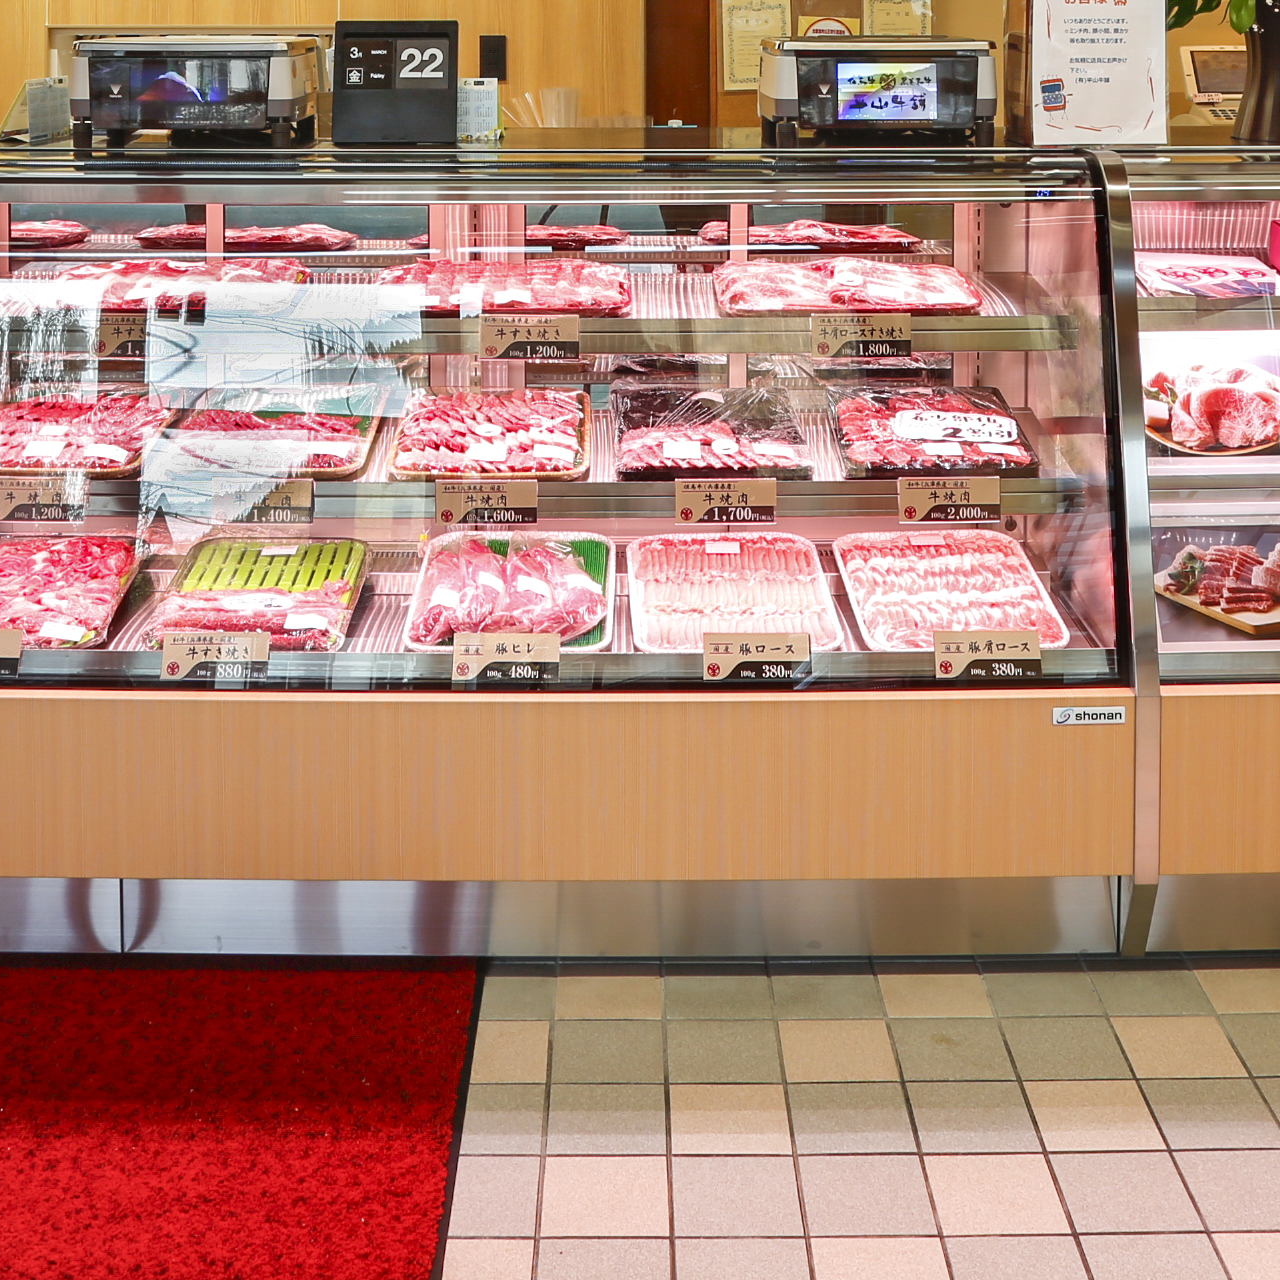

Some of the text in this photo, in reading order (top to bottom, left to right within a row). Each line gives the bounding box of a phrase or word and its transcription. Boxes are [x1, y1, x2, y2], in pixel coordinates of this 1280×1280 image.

[400, 47, 444, 78] 22
[349, 70, 361, 82] 金
[495, 328, 560, 340] 牛すき焼き
[819, 327, 904, 339] 牛肩ロースすき焼き
[526, 346, 564, 358] 1,200円
[859, 344, 896, 356] 1,800円
[5, 492, 62, 504] 牛焼肉
[465, 494, 506, 507] 牛焼肉
[703, 492, 748, 505] 牛焼肉
[928, 490, 970, 503] 牛焼肉
[32, 507, 69, 520] 1,200円
[253, 510, 298, 522] 1,400円
[484, 510, 522, 522] 1,600円
[713, 508, 759, 521] 1,700円
[948, 507, 988, 520] 2,000円
[186, 646, 249, 660] 牛すき焼き
[495, 642, 534, 655] 豚ヒレ
[739, 643, 795, 656] 豚ロース
[968, 640, 1030, 654] 豚肩ロース
[217, 664, 250, 678] 880円
[487, 665, 538, 678] 100g 480円
[740, 665, 792, 678] 100g 380円
[970, 663, 1022, 676] 100g 380円
[1075, 711, 1122, 721] shonan
